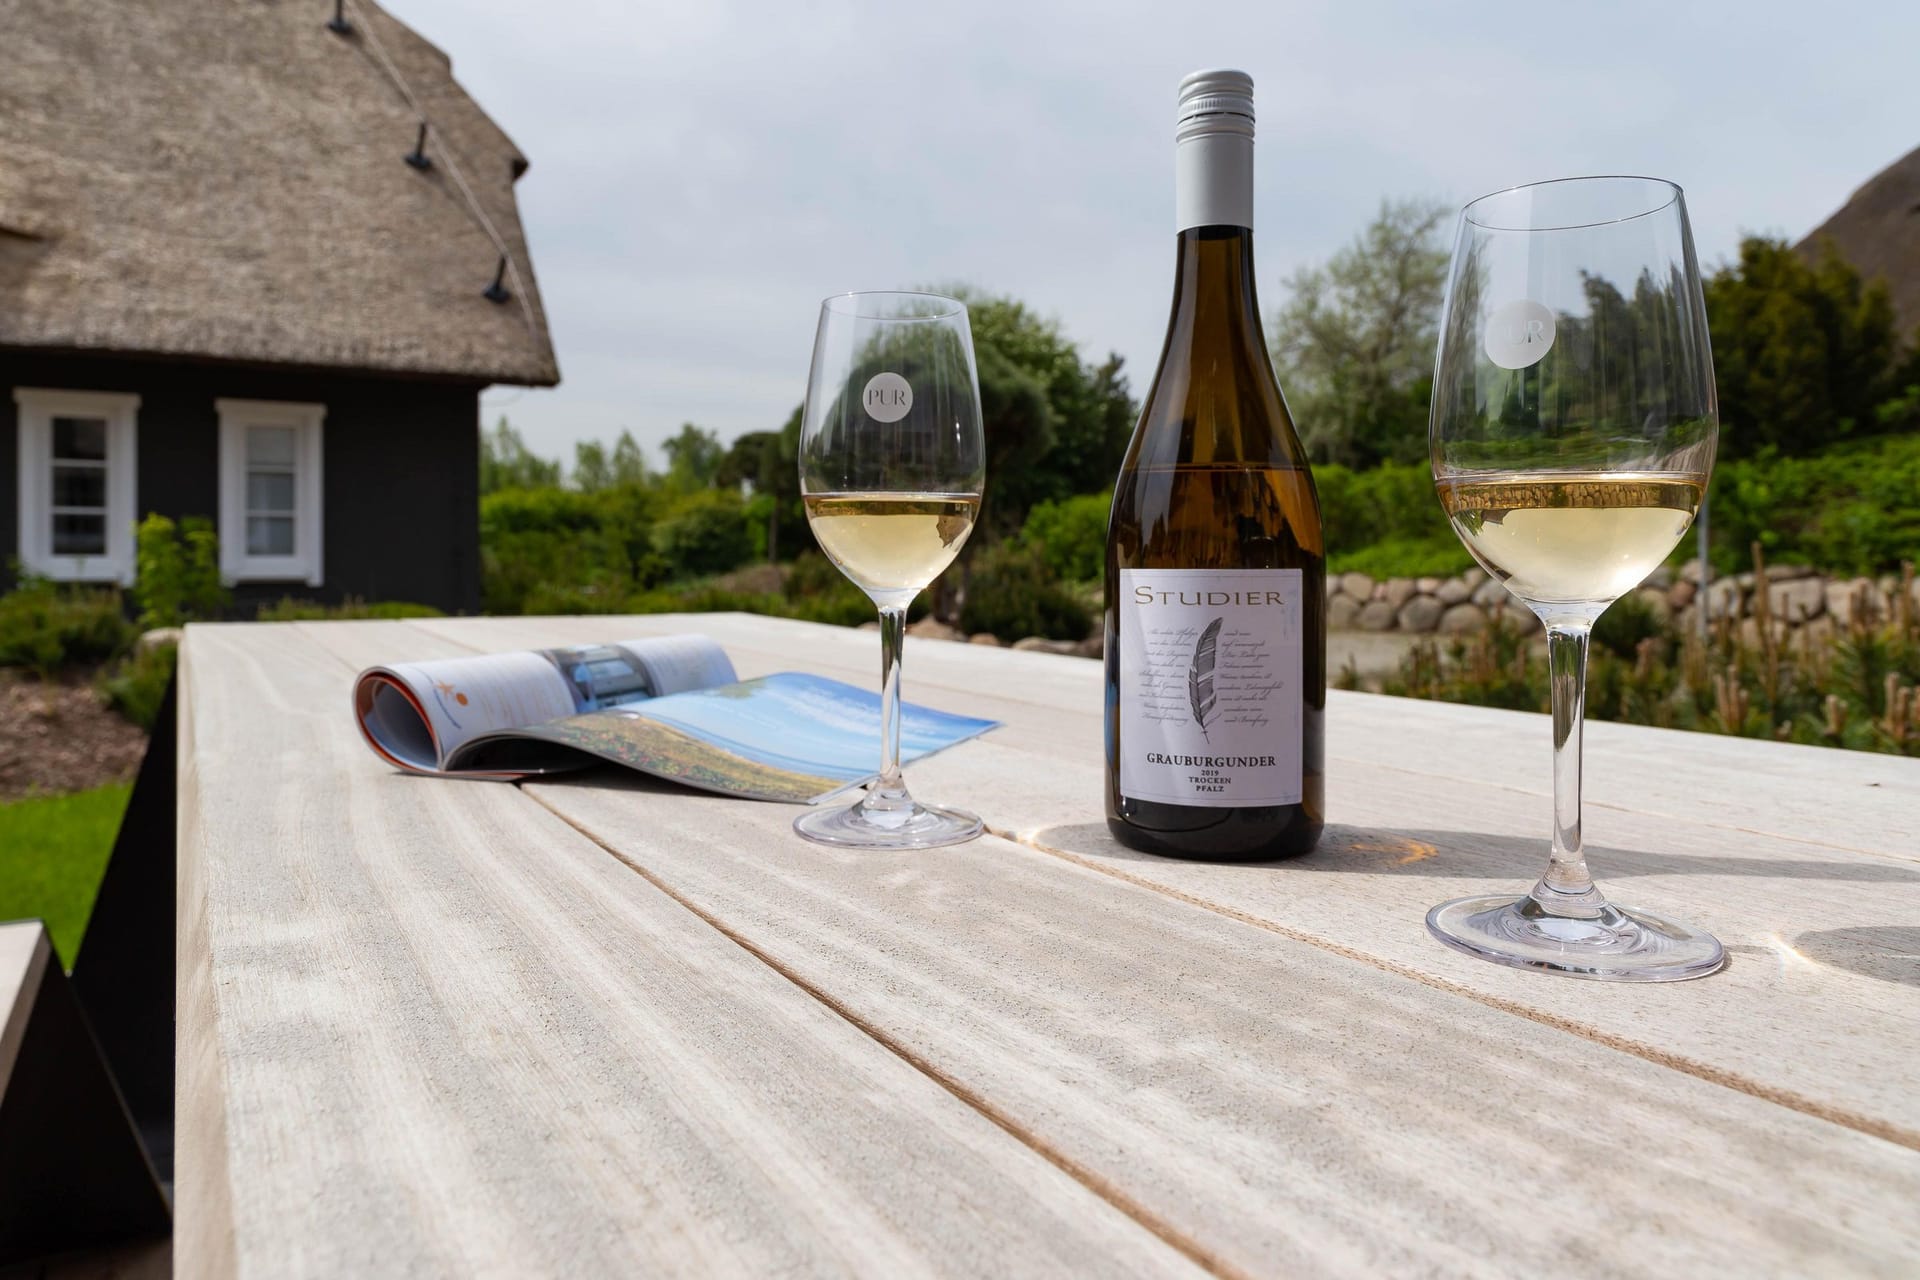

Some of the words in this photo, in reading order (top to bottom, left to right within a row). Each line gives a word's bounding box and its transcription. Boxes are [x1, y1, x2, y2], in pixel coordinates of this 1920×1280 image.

[869, 389, 906, 405] PUR
[1135, 586, 1286, 606] STUDIER
[1147, 752, 1276, 768] GRAUBURGUNDER
[1188, 776, 1232, 784] TROCKEN
[1195, 785, 1225, 793] PFALZ
